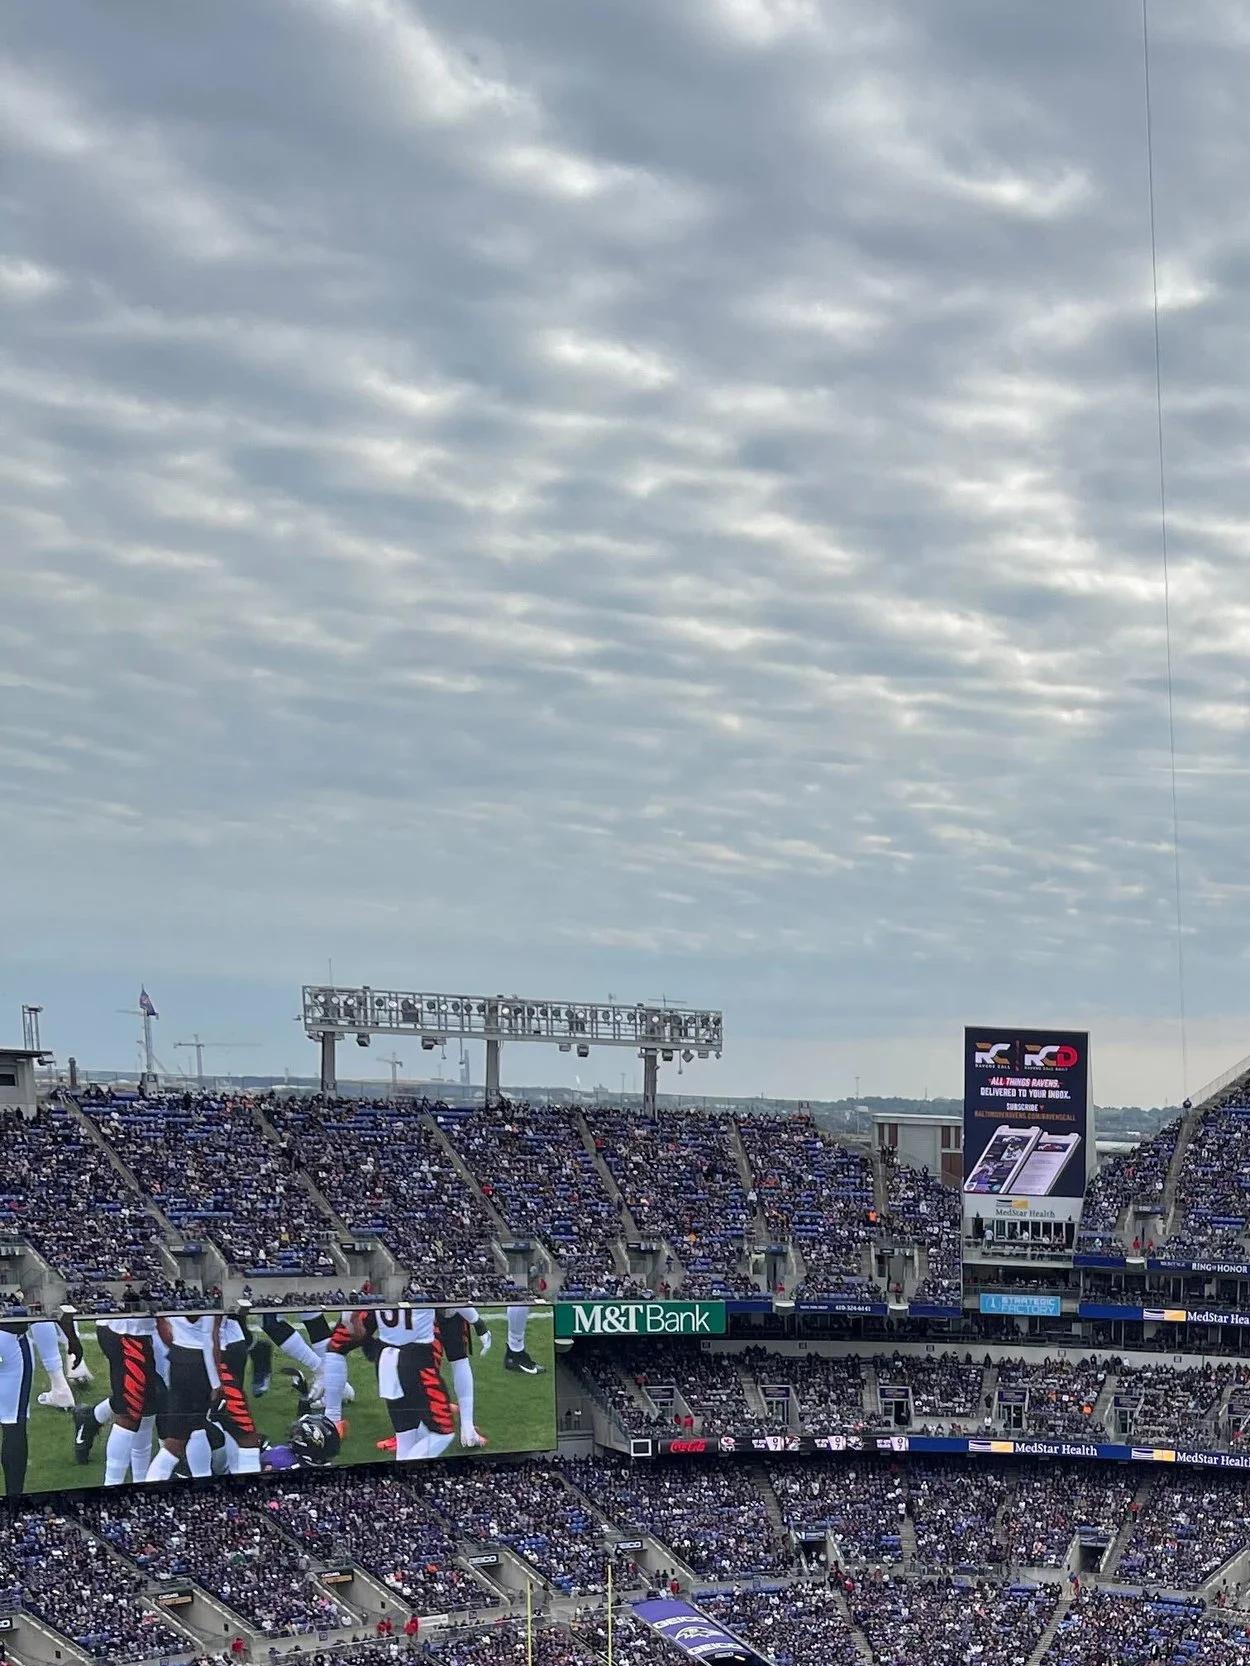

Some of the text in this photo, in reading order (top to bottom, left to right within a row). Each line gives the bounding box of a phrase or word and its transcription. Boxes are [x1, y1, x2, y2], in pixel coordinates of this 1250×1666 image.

[990, 1077, 1060, 1088] ALL THINGS RAVENS.
[980, 1087, 1071, 1100] DELIVERED TO YOUR INBOX.
[1006, 1102, 1039, 1112] SUBSCRIBE
[995, 1208, 1055, 1218] MedStar Health
[1001, 1296, 1056, 1306] STRATEGIC
[1001, 1305, 1056, 1313] FACTORY
[572, 1304, 710, 1333] M&T Bank
[1187, 1311, 1229, 1323] MedStar
[1015, 1442, 1098, 1456] MedStar Health
[1176, 1451, 1219, 1465] MedStar
[652, 1616, 710, 1629] GEICO
[687, 1643, 743, 1655] GEICO
